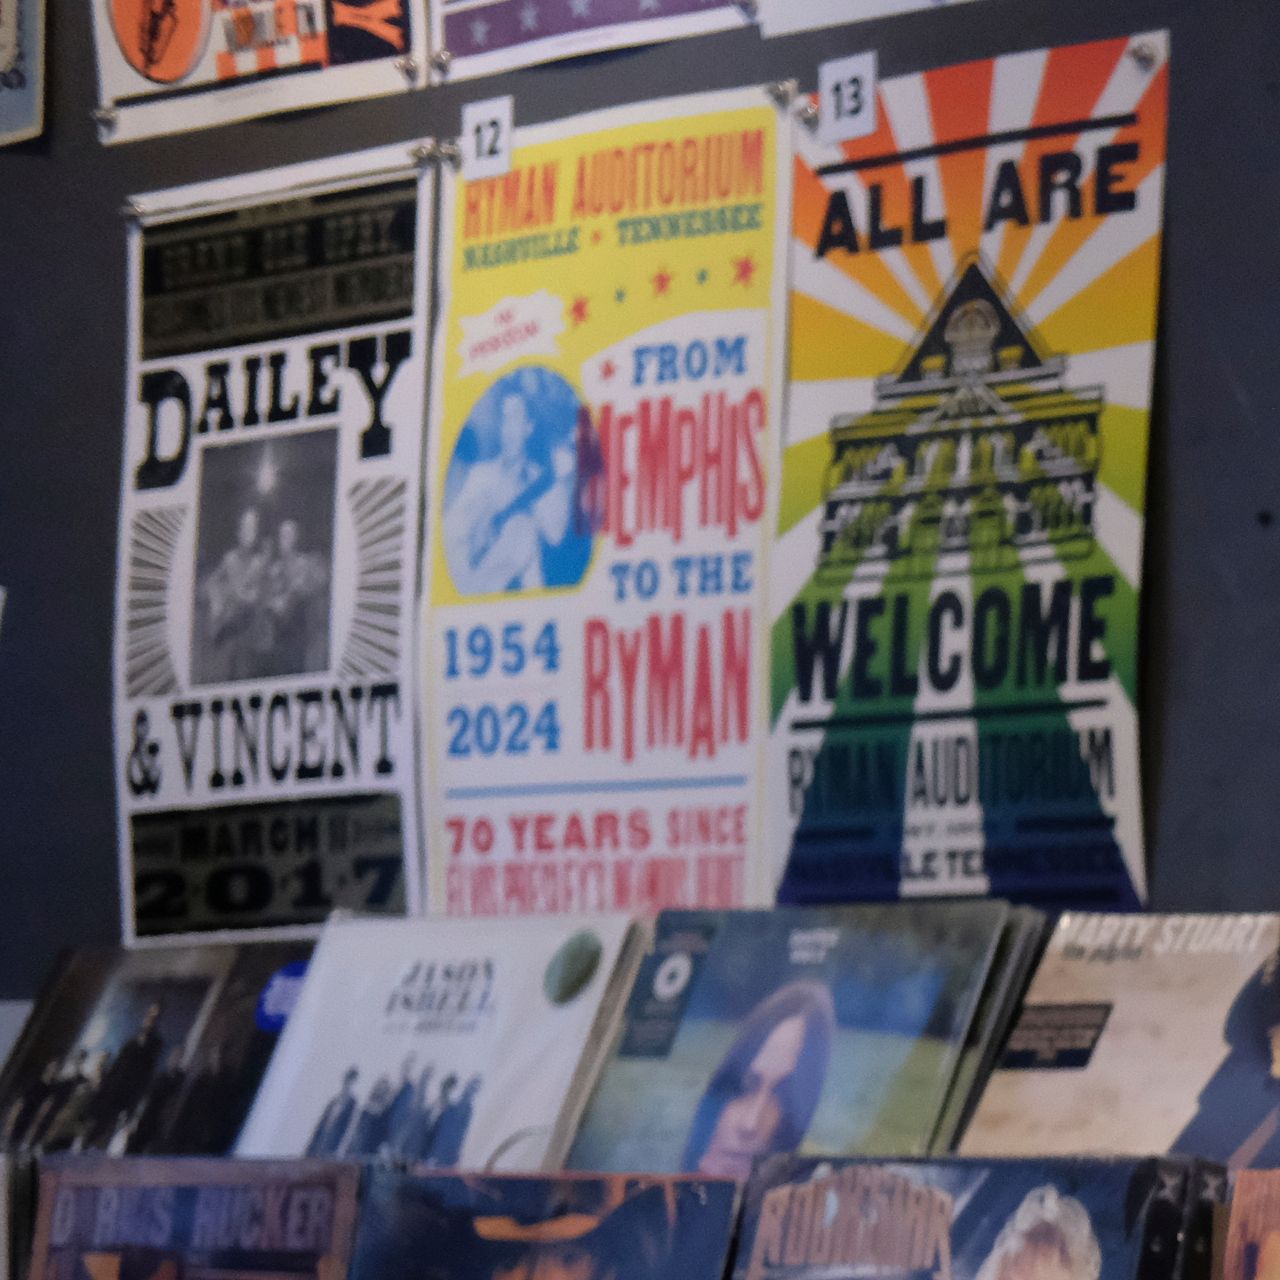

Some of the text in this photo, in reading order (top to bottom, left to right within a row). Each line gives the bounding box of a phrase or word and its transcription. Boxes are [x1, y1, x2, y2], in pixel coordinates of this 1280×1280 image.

[830, 76, 863, 120] 13
[474, 119, 501, 157] 12
[572, 128, 765, 220] AUDITORIUM
[815, 142, 1139, 259] ALL ARE
[463, 203, 764, 270] NASHVILLE TENNESSEE
[632, 335, 748, 387] FROM
[136, 330, 412, 490] DAILEY
[575, 389, 766, 544] MEMPHIS
[610, 553, 754, 601] TO THE
[792, 575, 1117, 702] WELCOME
[444, 608, 750, 763] 1954 RYMAN
[126, 682, 399, 797] & VINCENT
[447, 702, 560, 758] 2024
[446, 802, 749, 855] 70 YEARS SINCE
[133, 854, 401, 920] 2017
